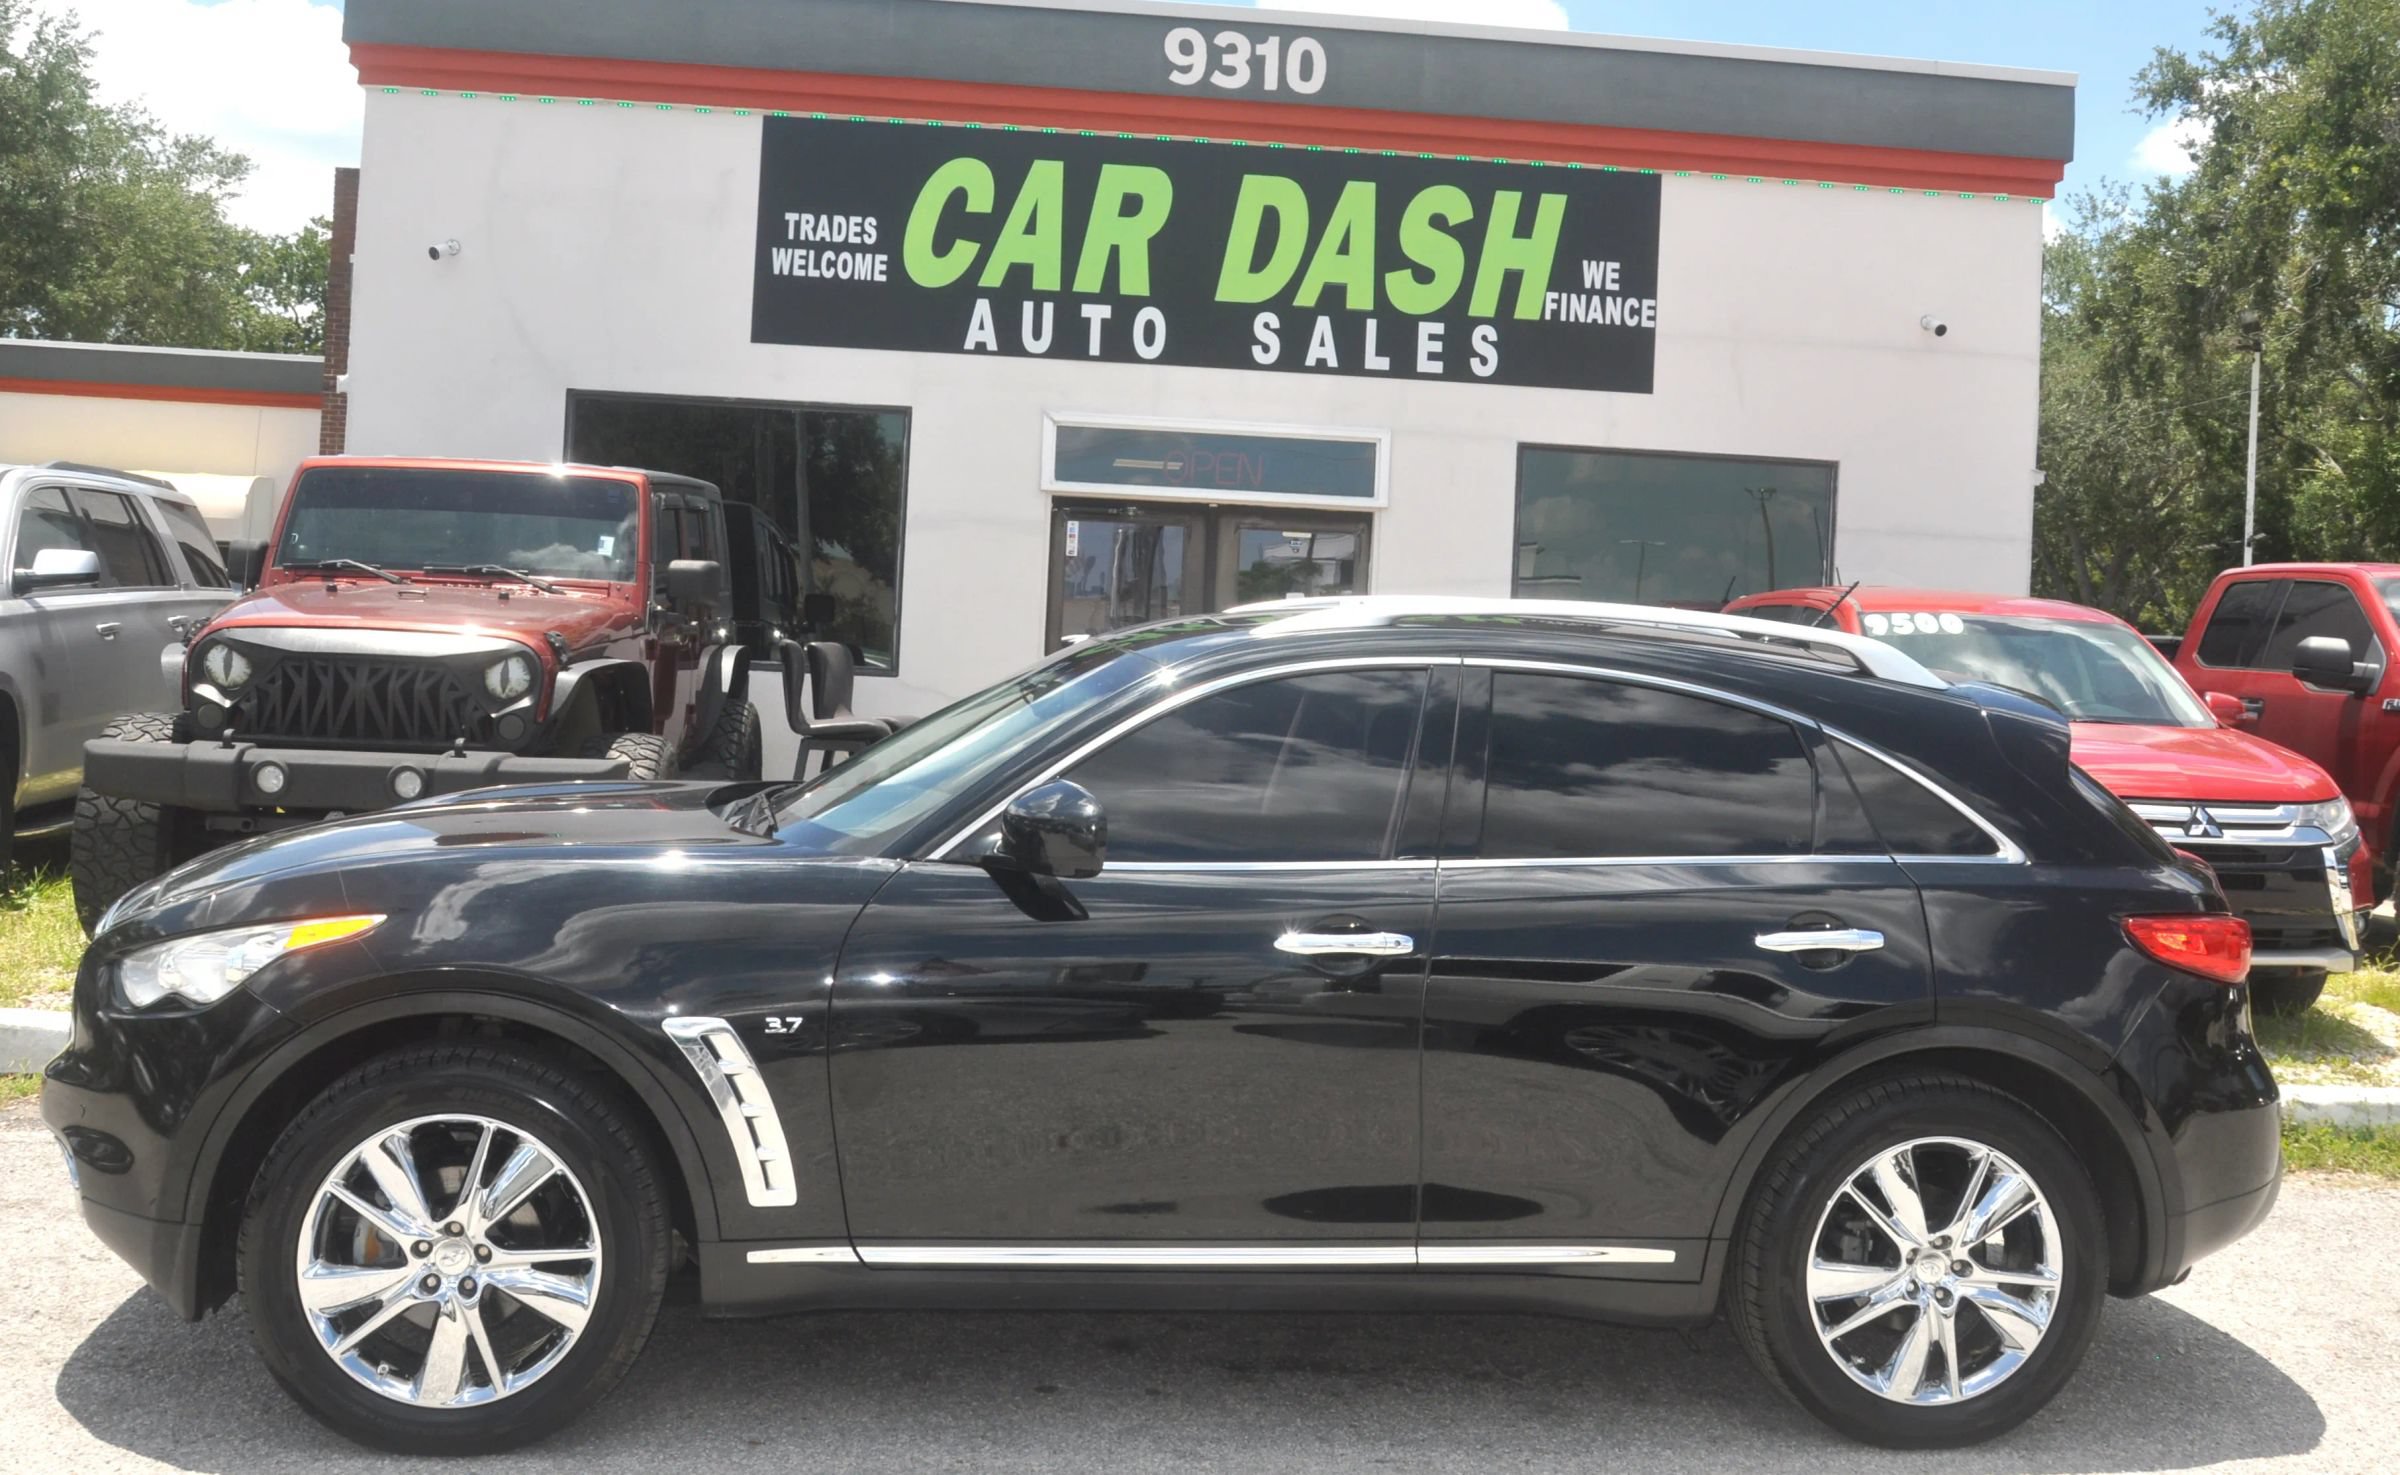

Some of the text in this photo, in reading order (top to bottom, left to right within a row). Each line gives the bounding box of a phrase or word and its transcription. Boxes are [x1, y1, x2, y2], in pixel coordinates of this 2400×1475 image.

[1164, 27, 1327, 94] 9310
[785, 212, 877, 245] TRADES
[903, 158, 1567, 320] CAR DASH
[772, 247, 888, 282] WELCOME
[1582, 259, 1620, 290] WE
[1544, 291, 1656, 328] FINANCE
[964, 299, 1499, 377] AUTO SALES
[1164, 449, 1264, 486] OPEN
[1863, 612, 1964, 636] 9500
